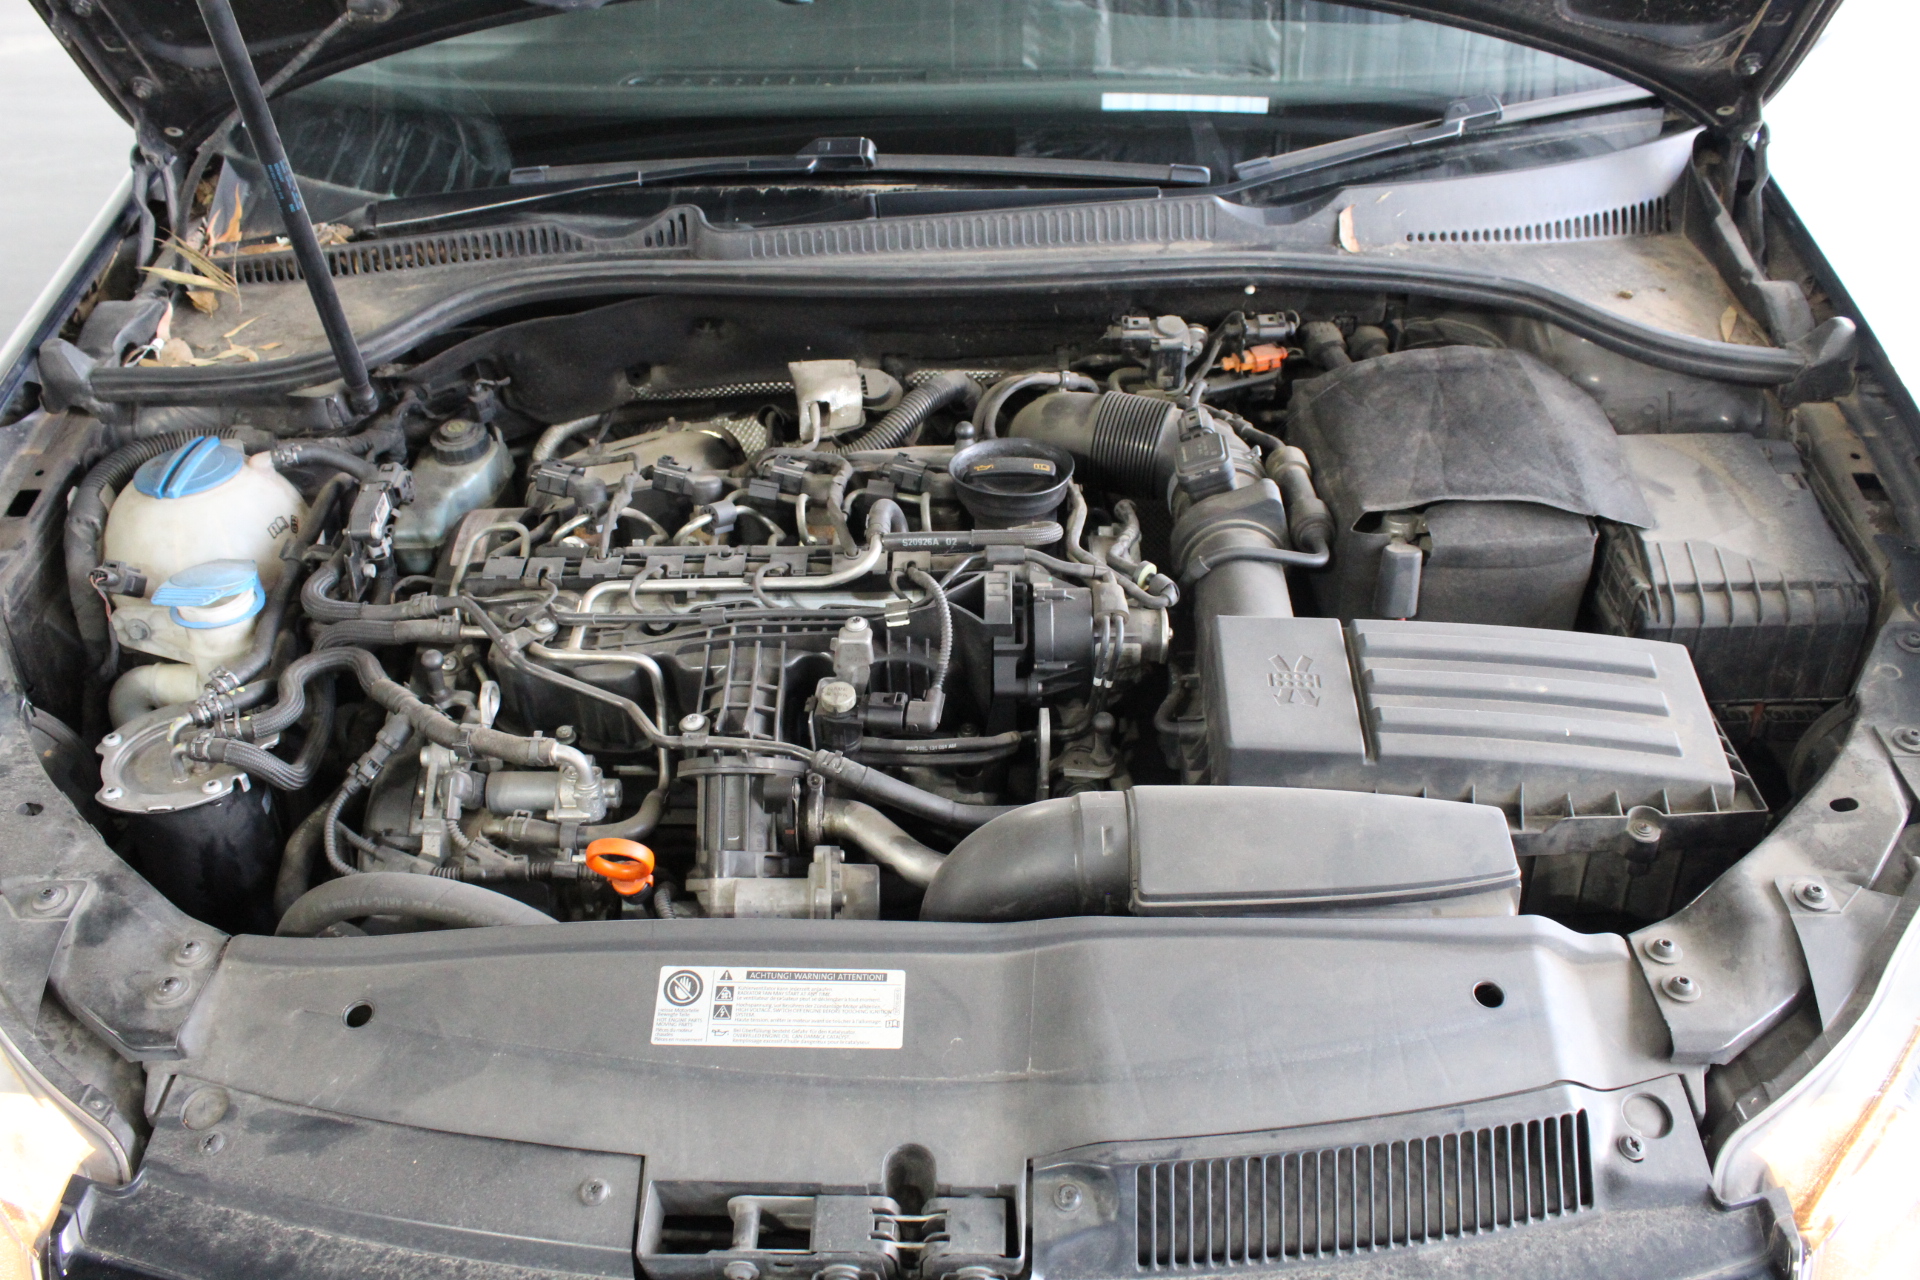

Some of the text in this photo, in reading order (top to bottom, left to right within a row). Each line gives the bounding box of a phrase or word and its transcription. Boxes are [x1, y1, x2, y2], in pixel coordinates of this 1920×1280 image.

[945, 537, 958, 546] 02
[749, 972, 884, 982] ACHTUNG! WARNING! ATTENTION!
